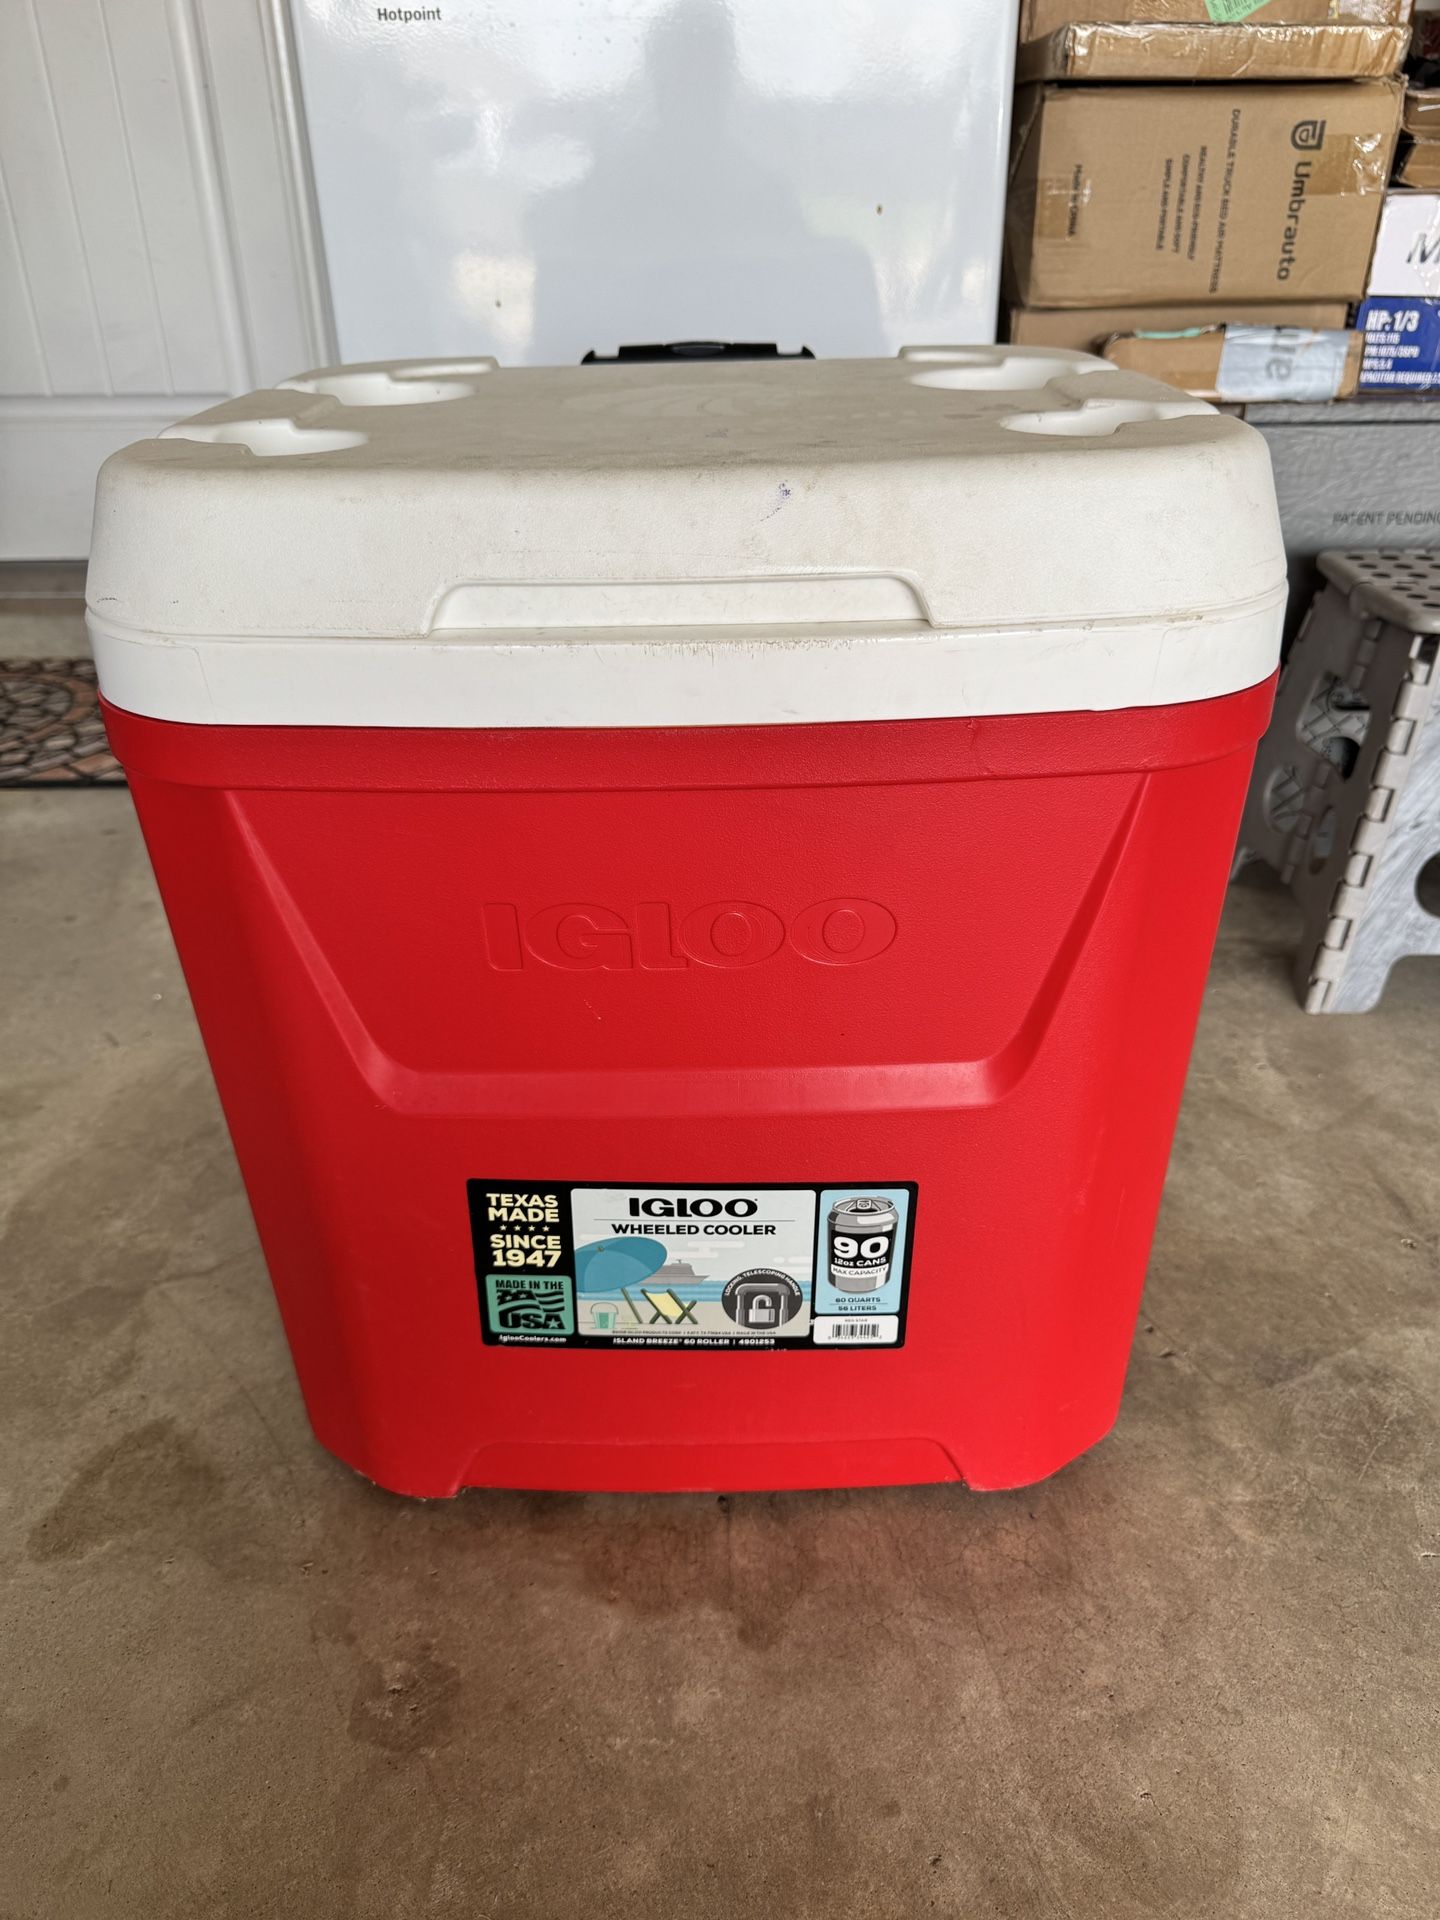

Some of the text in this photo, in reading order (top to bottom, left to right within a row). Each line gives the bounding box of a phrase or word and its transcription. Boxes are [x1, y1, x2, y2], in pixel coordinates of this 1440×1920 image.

[377, 6, 442, 23] Hotpoint
[1227, 109, 1241, 158] DURABLE
[1222, 161, 1234, 195] TRUCK
[1219, 198, 1229, 218] BED
[1277, 161, 1312, 280] Umbrauto
[1216, 221, 1226, 238] AIR
[1332, 511, 1384, 526] PATENT
[483, 897, 897, 971] IGLOO
[486, 1193, 559, 1208] TEXAS
[629, 1197, 758, 1217] IGLOO
[488, 1207, 560, 1223] MADE
[611, 1223, 776, 1235] WHEELED COOLER
[490, 1234, 562, 1250] SINCE
[833, 1236, 890, 1259] 90
[492, 1249, 562, 1268] 1947
[834, 1256, 887, 1267] 12oz CANS
[832, 1266, 887, 1276] MAX CAPACITY
[495, 1279, 564, 1290] MADE IN THE
[743, 1269, 786, 1279] TELESCOPING
[785, 1276, 800, 1296] HANDLE
[498, 1311, 566, 1330] USA
[499, 1334, 567, 1343] IglooCoolers.com
[613, 1337, 645, 1345] ISLAND
[697, 1338, 730, 1346] ROLLER
[738, 1338, 776, 1346] 4901253
